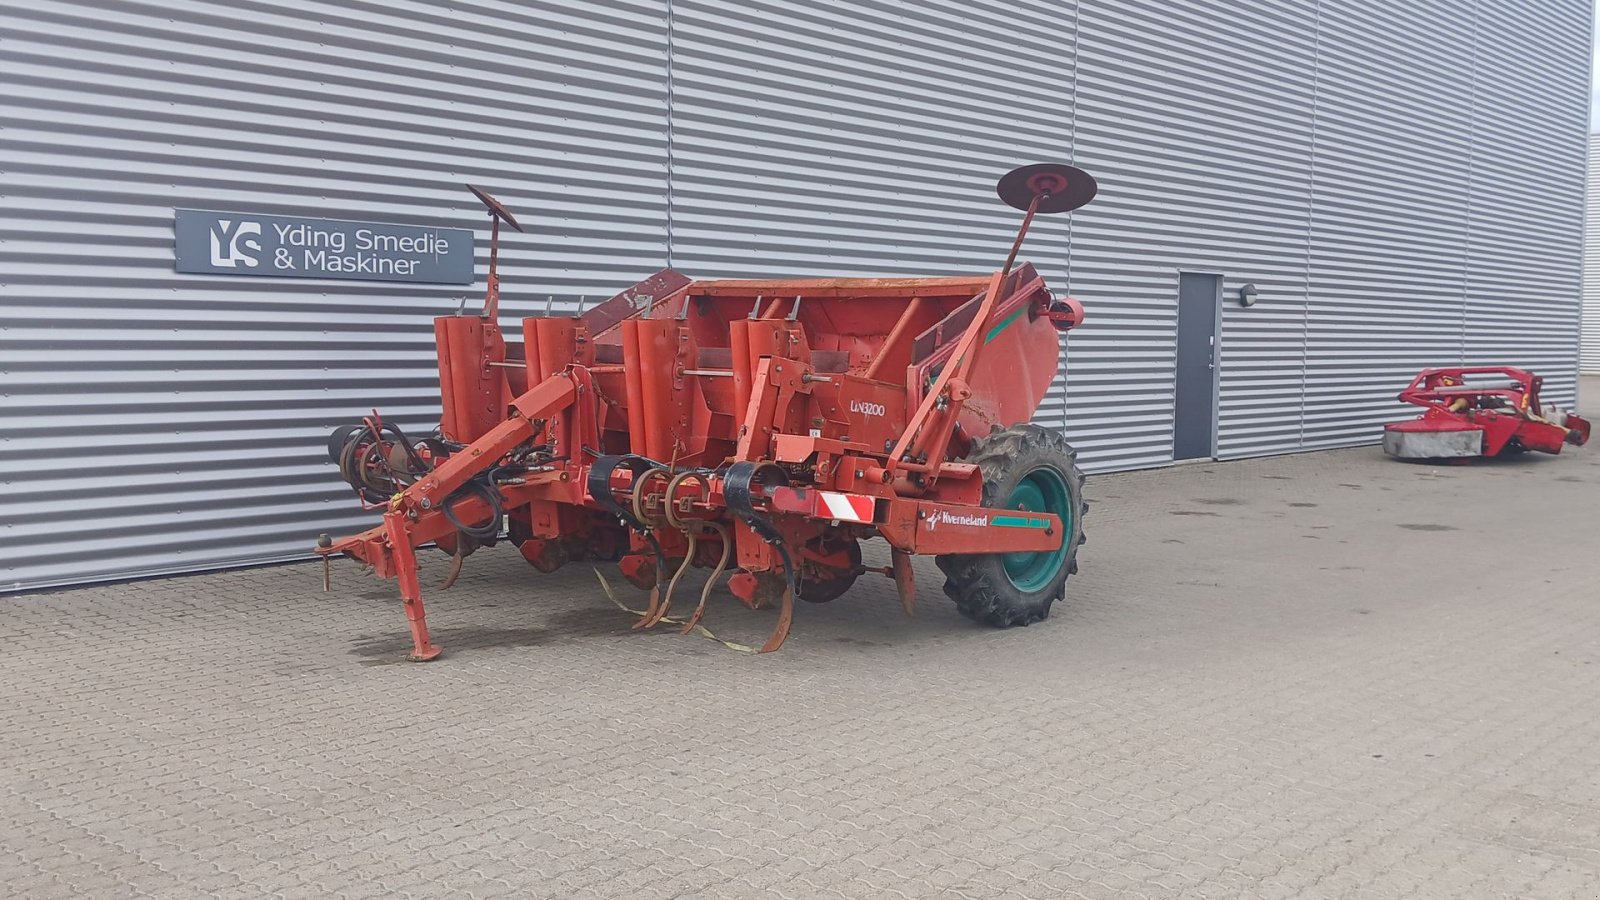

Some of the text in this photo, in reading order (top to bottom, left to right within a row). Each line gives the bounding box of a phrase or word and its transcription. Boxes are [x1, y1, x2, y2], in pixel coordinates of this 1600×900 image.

[272, 223, 449, 255] Yding Smedie
[273, 248, 421, 275] & Maskiner
[942, 511, 988, 527] Kverneland
